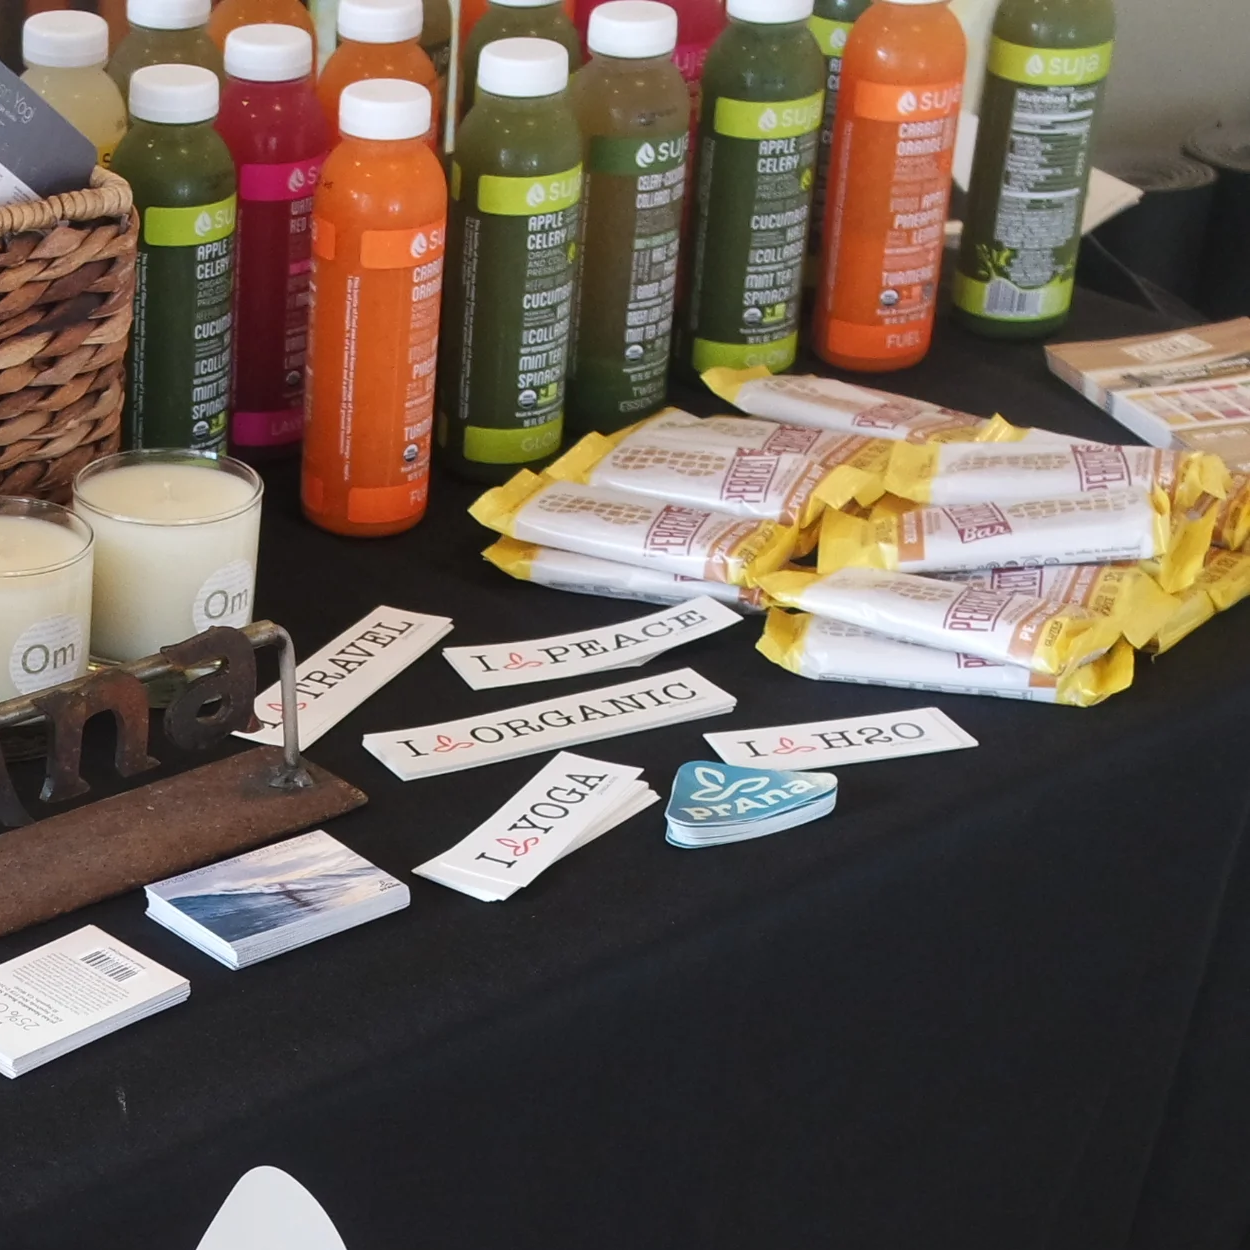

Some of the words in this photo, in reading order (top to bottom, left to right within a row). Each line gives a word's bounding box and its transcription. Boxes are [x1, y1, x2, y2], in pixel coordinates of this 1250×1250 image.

[1048, 53, 1099, 80] suja
[13, 90, 36, 124] Yogi
[759, 138, 796, 155] APPLE
[757, 154, 800, 173] CELERY
[528, 211, 563, 232] APPLE
[196, 239, 227, 261] APPLE
[527, 228, 567, 250] CELERY
[886, 330, 921, 348] FUEL
[519, 354, 547, 371] MINT
[549, 348, 562, 366] TEA
[517, 366, 561, 389] SPINACH
[193, 382, 218, 402] MINT
[964, 525, 1005, 542] Bar
[203, 586, 250, 619] Om
[470, 654, 498, 673] I
[541, 609, 708, 664] PEACE
[20, 639, 75, 676] Om
[296, 618, 413, 701] TRAVEL
[396, 739, 429, 759] I
[469, 682, 700, 746] ORGANIC
[738, 740, 768, 758] I
[679, 776, 818, 822] prAna
[476, 852, 518, 870] I
[508, 770, 610, 836] YOGA
[4, 1010, 41, 1031] 25%
